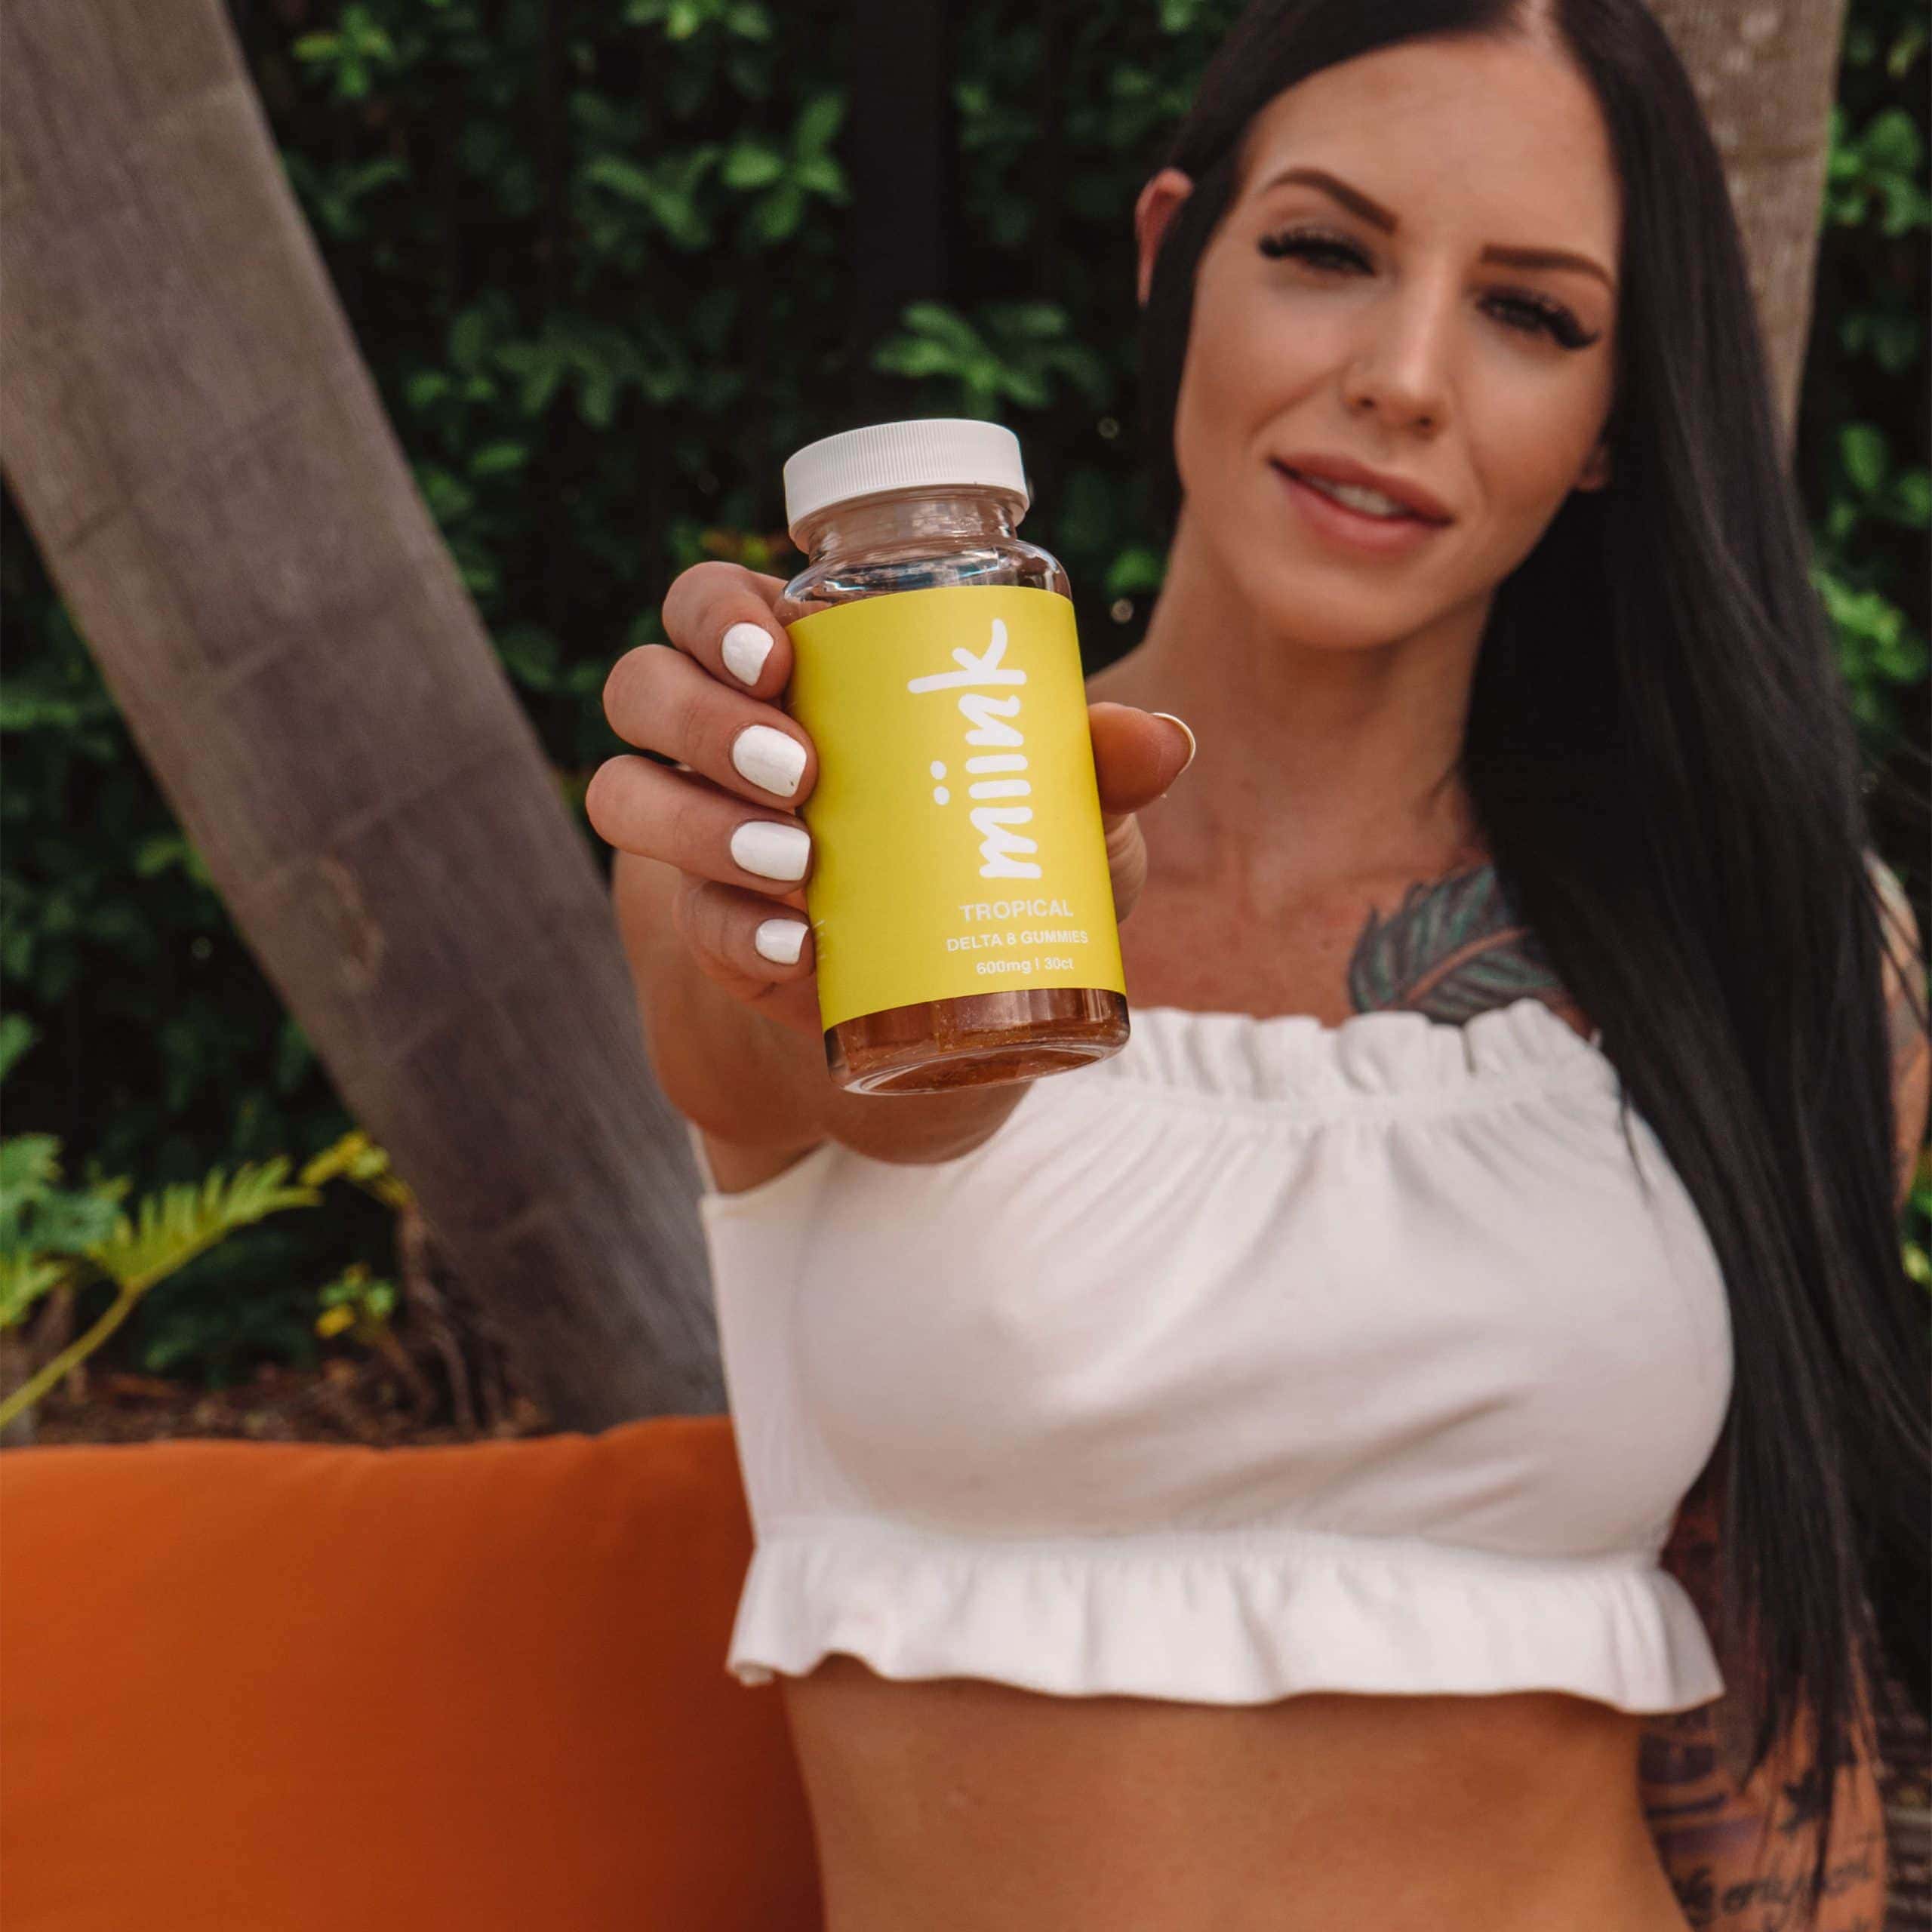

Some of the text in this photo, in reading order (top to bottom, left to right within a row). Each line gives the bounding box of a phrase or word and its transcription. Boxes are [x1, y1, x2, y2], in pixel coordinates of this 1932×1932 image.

[958, 898, 1074, 922] TROPICAL
[946, 929, 1090, 952] DELTA 8 GUMMIES
[975, 960, 1033, 975] 600mg
[1044, 957, 1075, 971] 30ct
